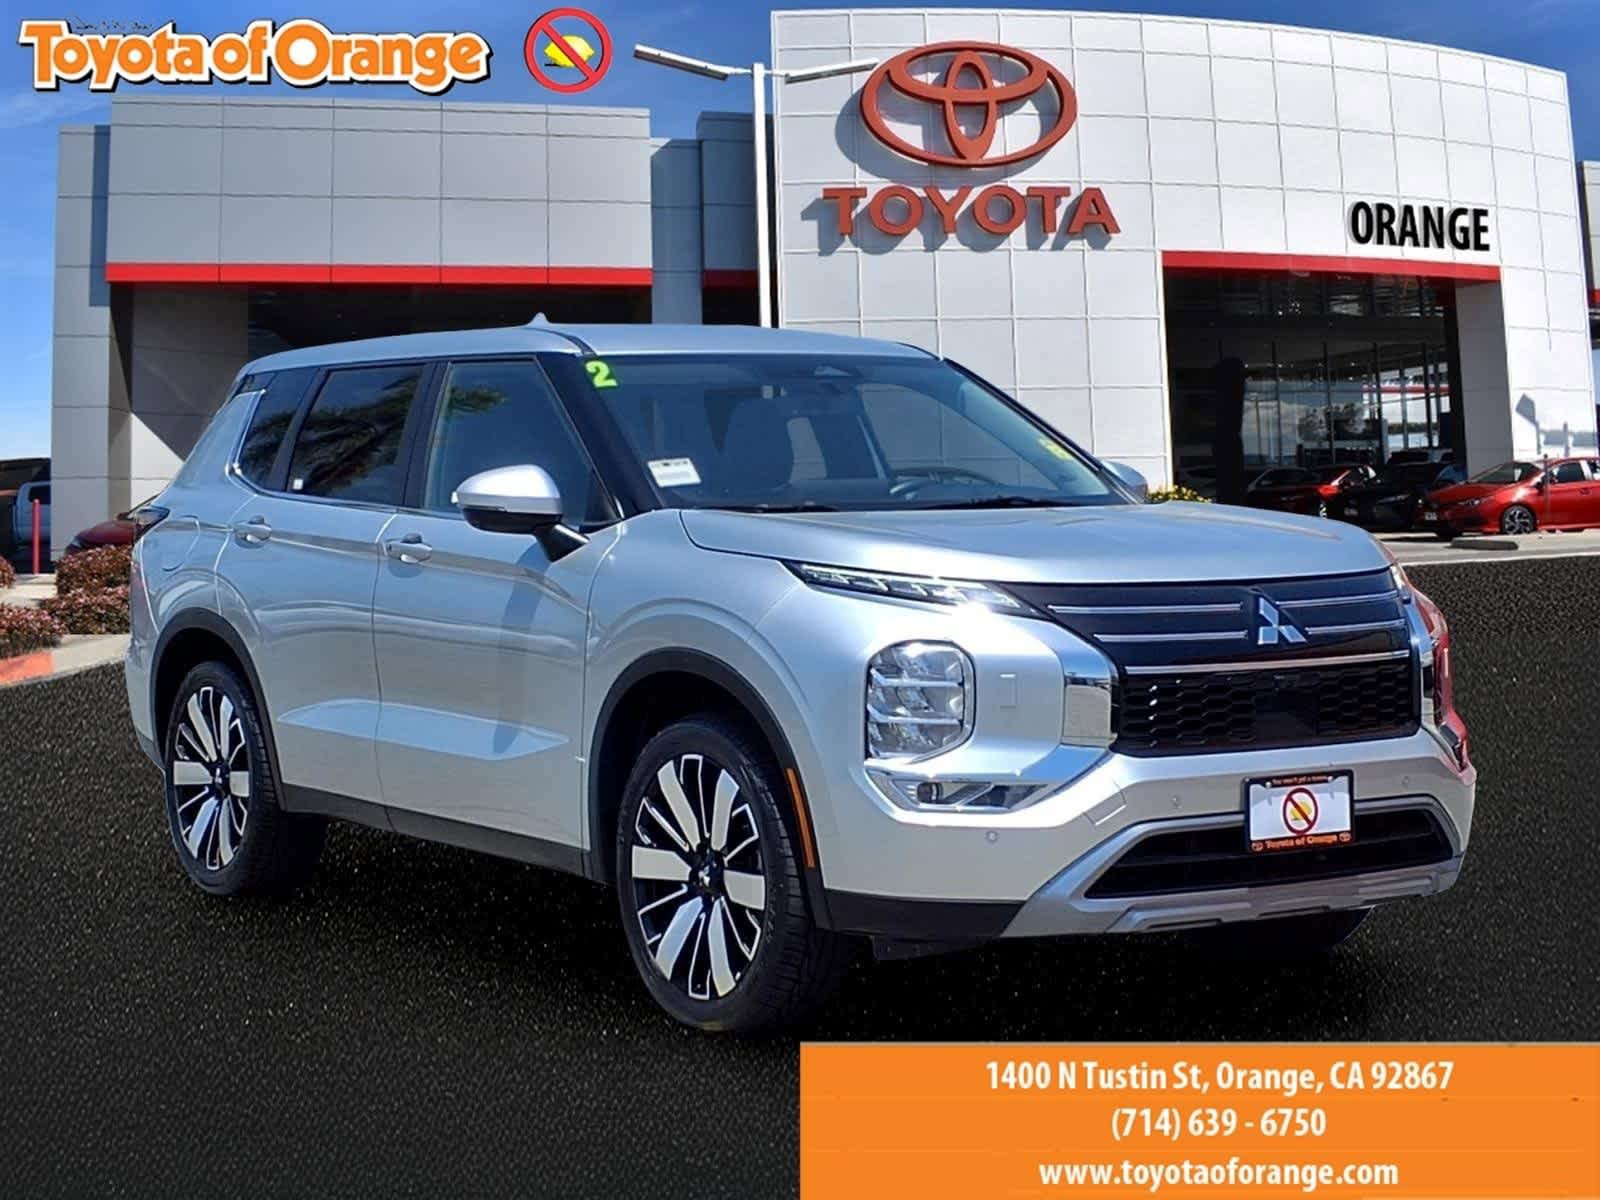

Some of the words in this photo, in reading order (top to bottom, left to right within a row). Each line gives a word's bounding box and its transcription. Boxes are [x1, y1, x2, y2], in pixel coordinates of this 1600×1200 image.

[822, 184, 1120, 236] TOYOTA
[1350, 201, 1490, 251] ORANGE
[585, 360, 617, 388] 2
